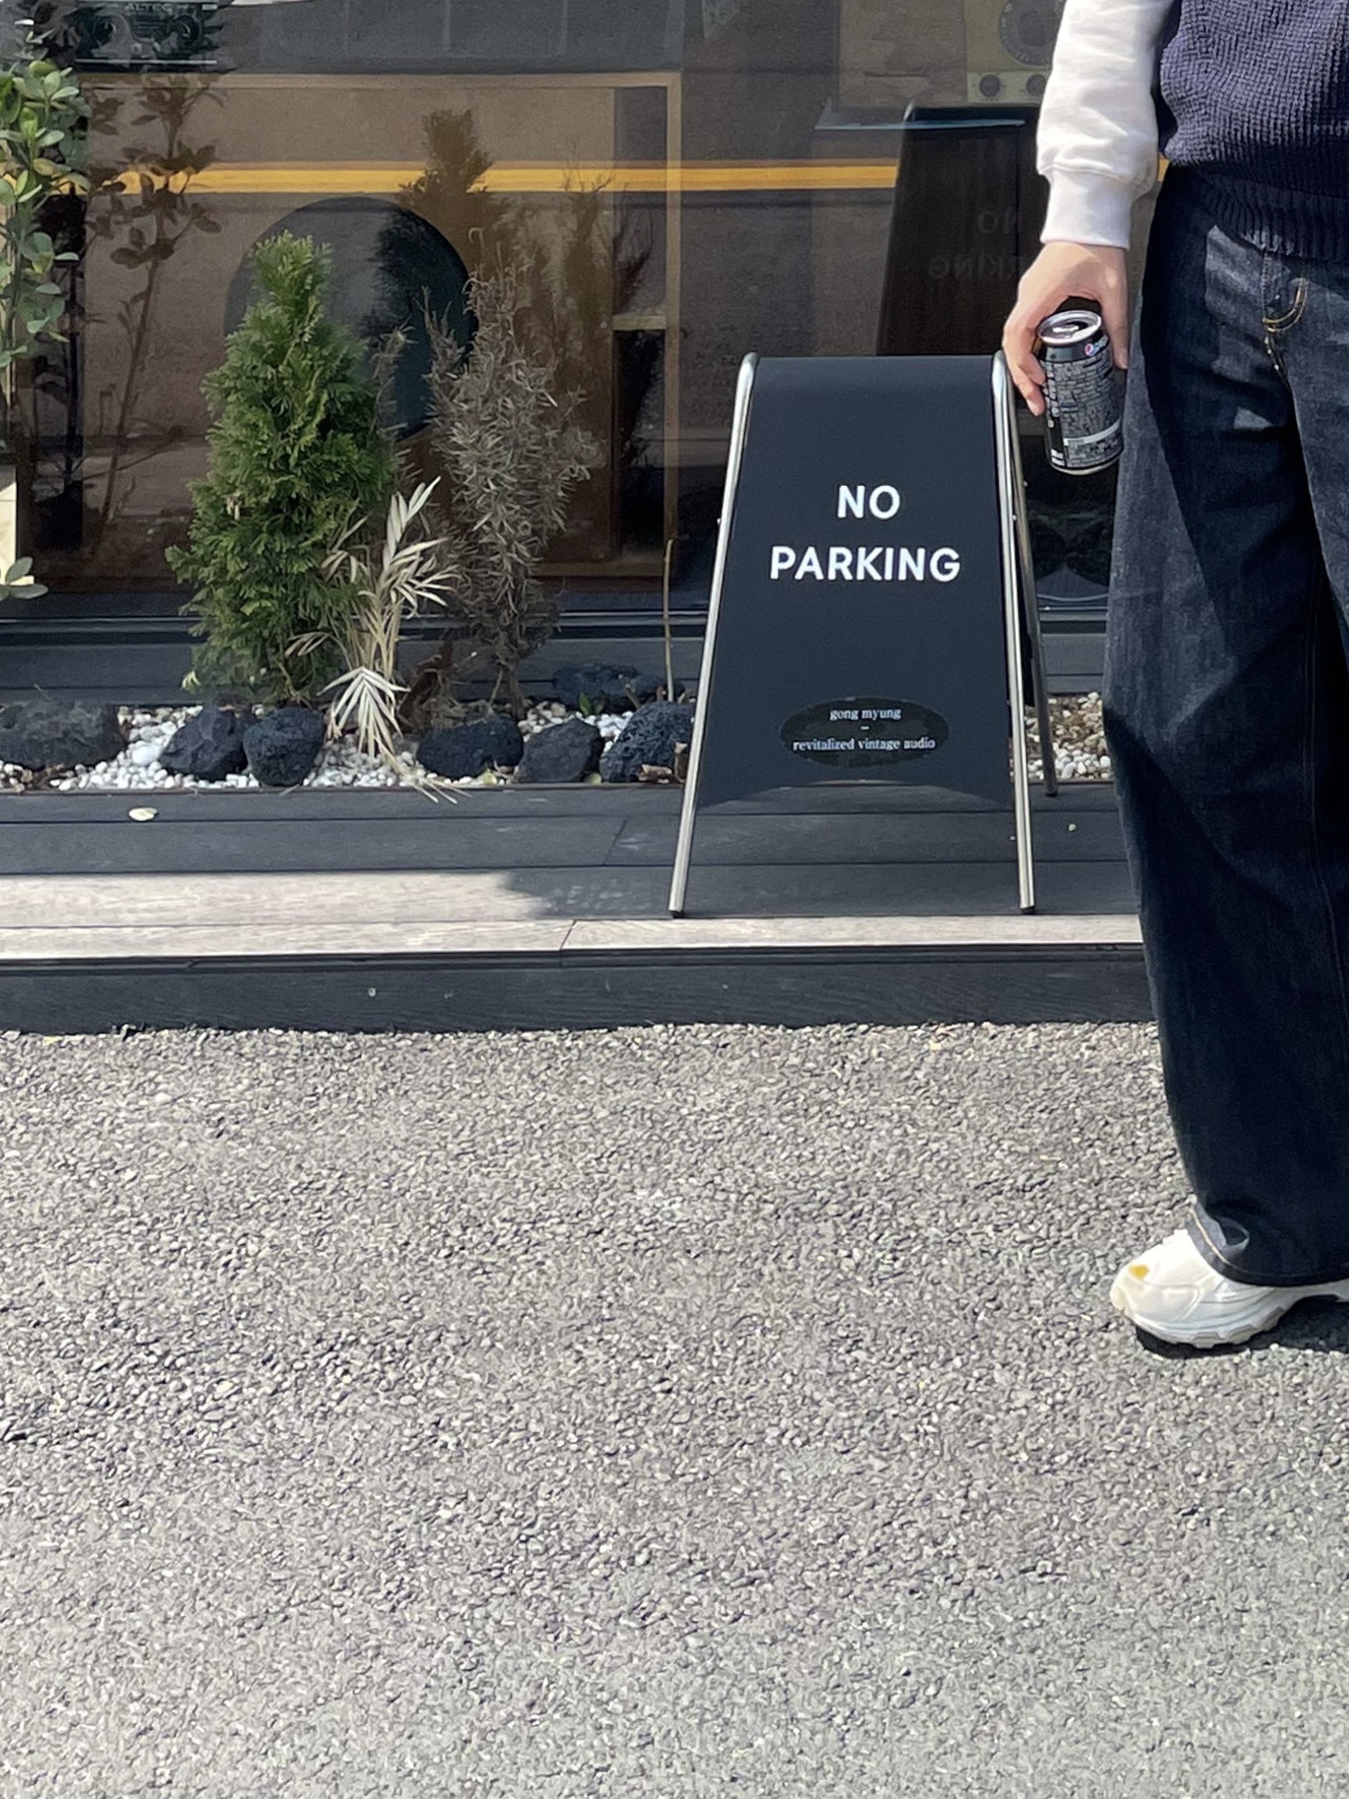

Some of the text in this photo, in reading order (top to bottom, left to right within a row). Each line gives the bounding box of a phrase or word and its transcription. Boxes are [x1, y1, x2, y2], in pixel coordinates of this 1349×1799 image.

[837, 485, 901, 520] NO
[770, 545, 961, 583] PARKING
[829, 708, 902, 721] gong myung
[792, 735, 936, 751] revitalized vintage audio
